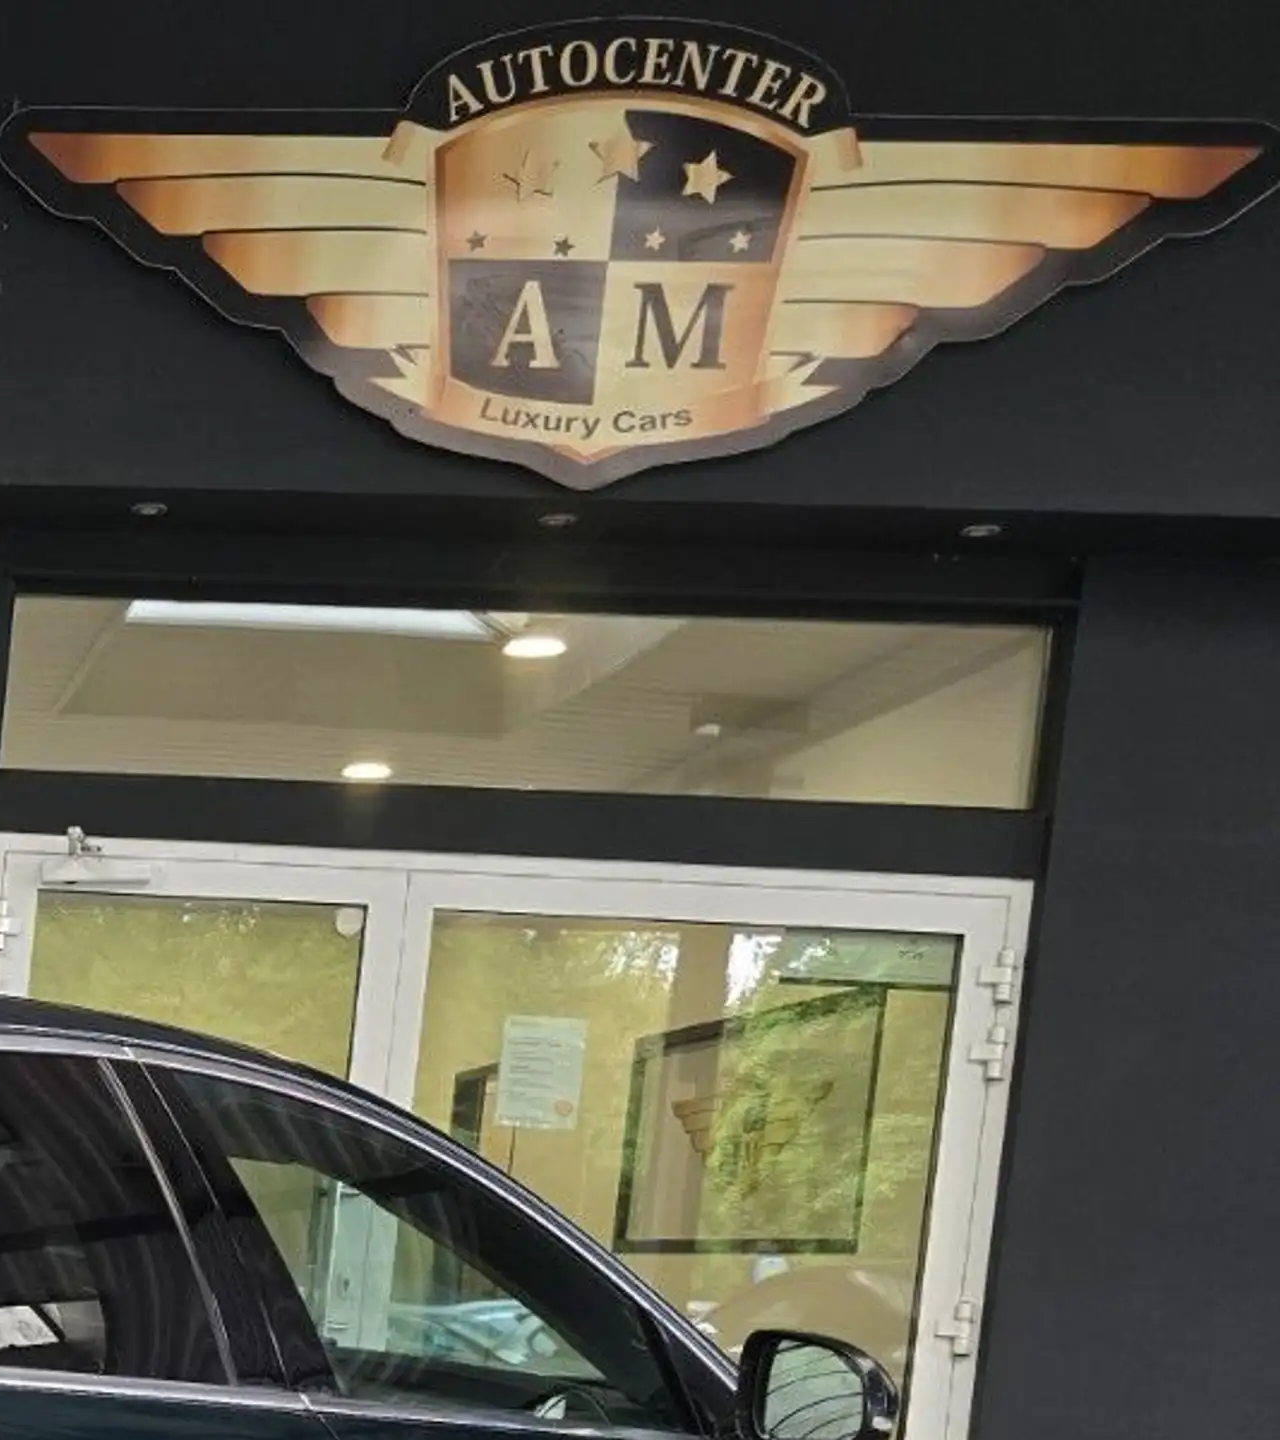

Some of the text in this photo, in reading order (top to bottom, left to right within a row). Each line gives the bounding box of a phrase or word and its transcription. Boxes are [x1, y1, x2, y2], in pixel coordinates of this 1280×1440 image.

[448, 36, 828, 128] AUTOCENTER
[491, 279, 736, 370] A M
[479, 398, 694, 440] Luxury Cars
